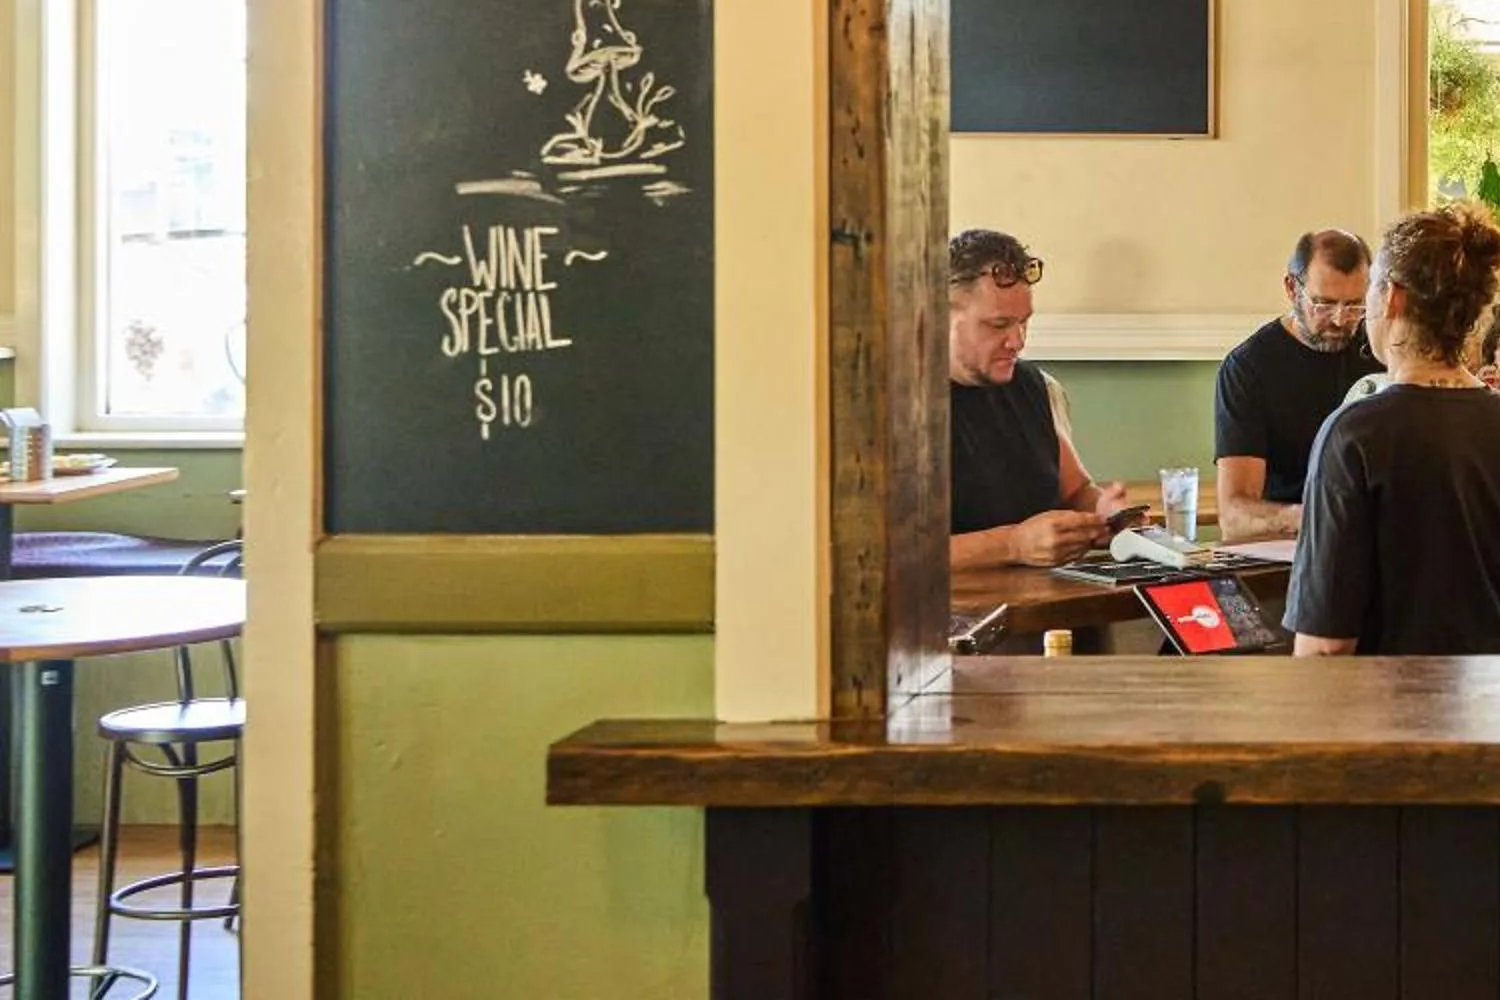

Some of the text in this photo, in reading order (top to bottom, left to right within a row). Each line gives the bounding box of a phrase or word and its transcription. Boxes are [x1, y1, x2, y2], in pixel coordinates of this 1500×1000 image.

[463, 224, 559, 291] WINE
[440, 287, 573, 357] SPECIAL
[474, 358, 532, 440] $10
